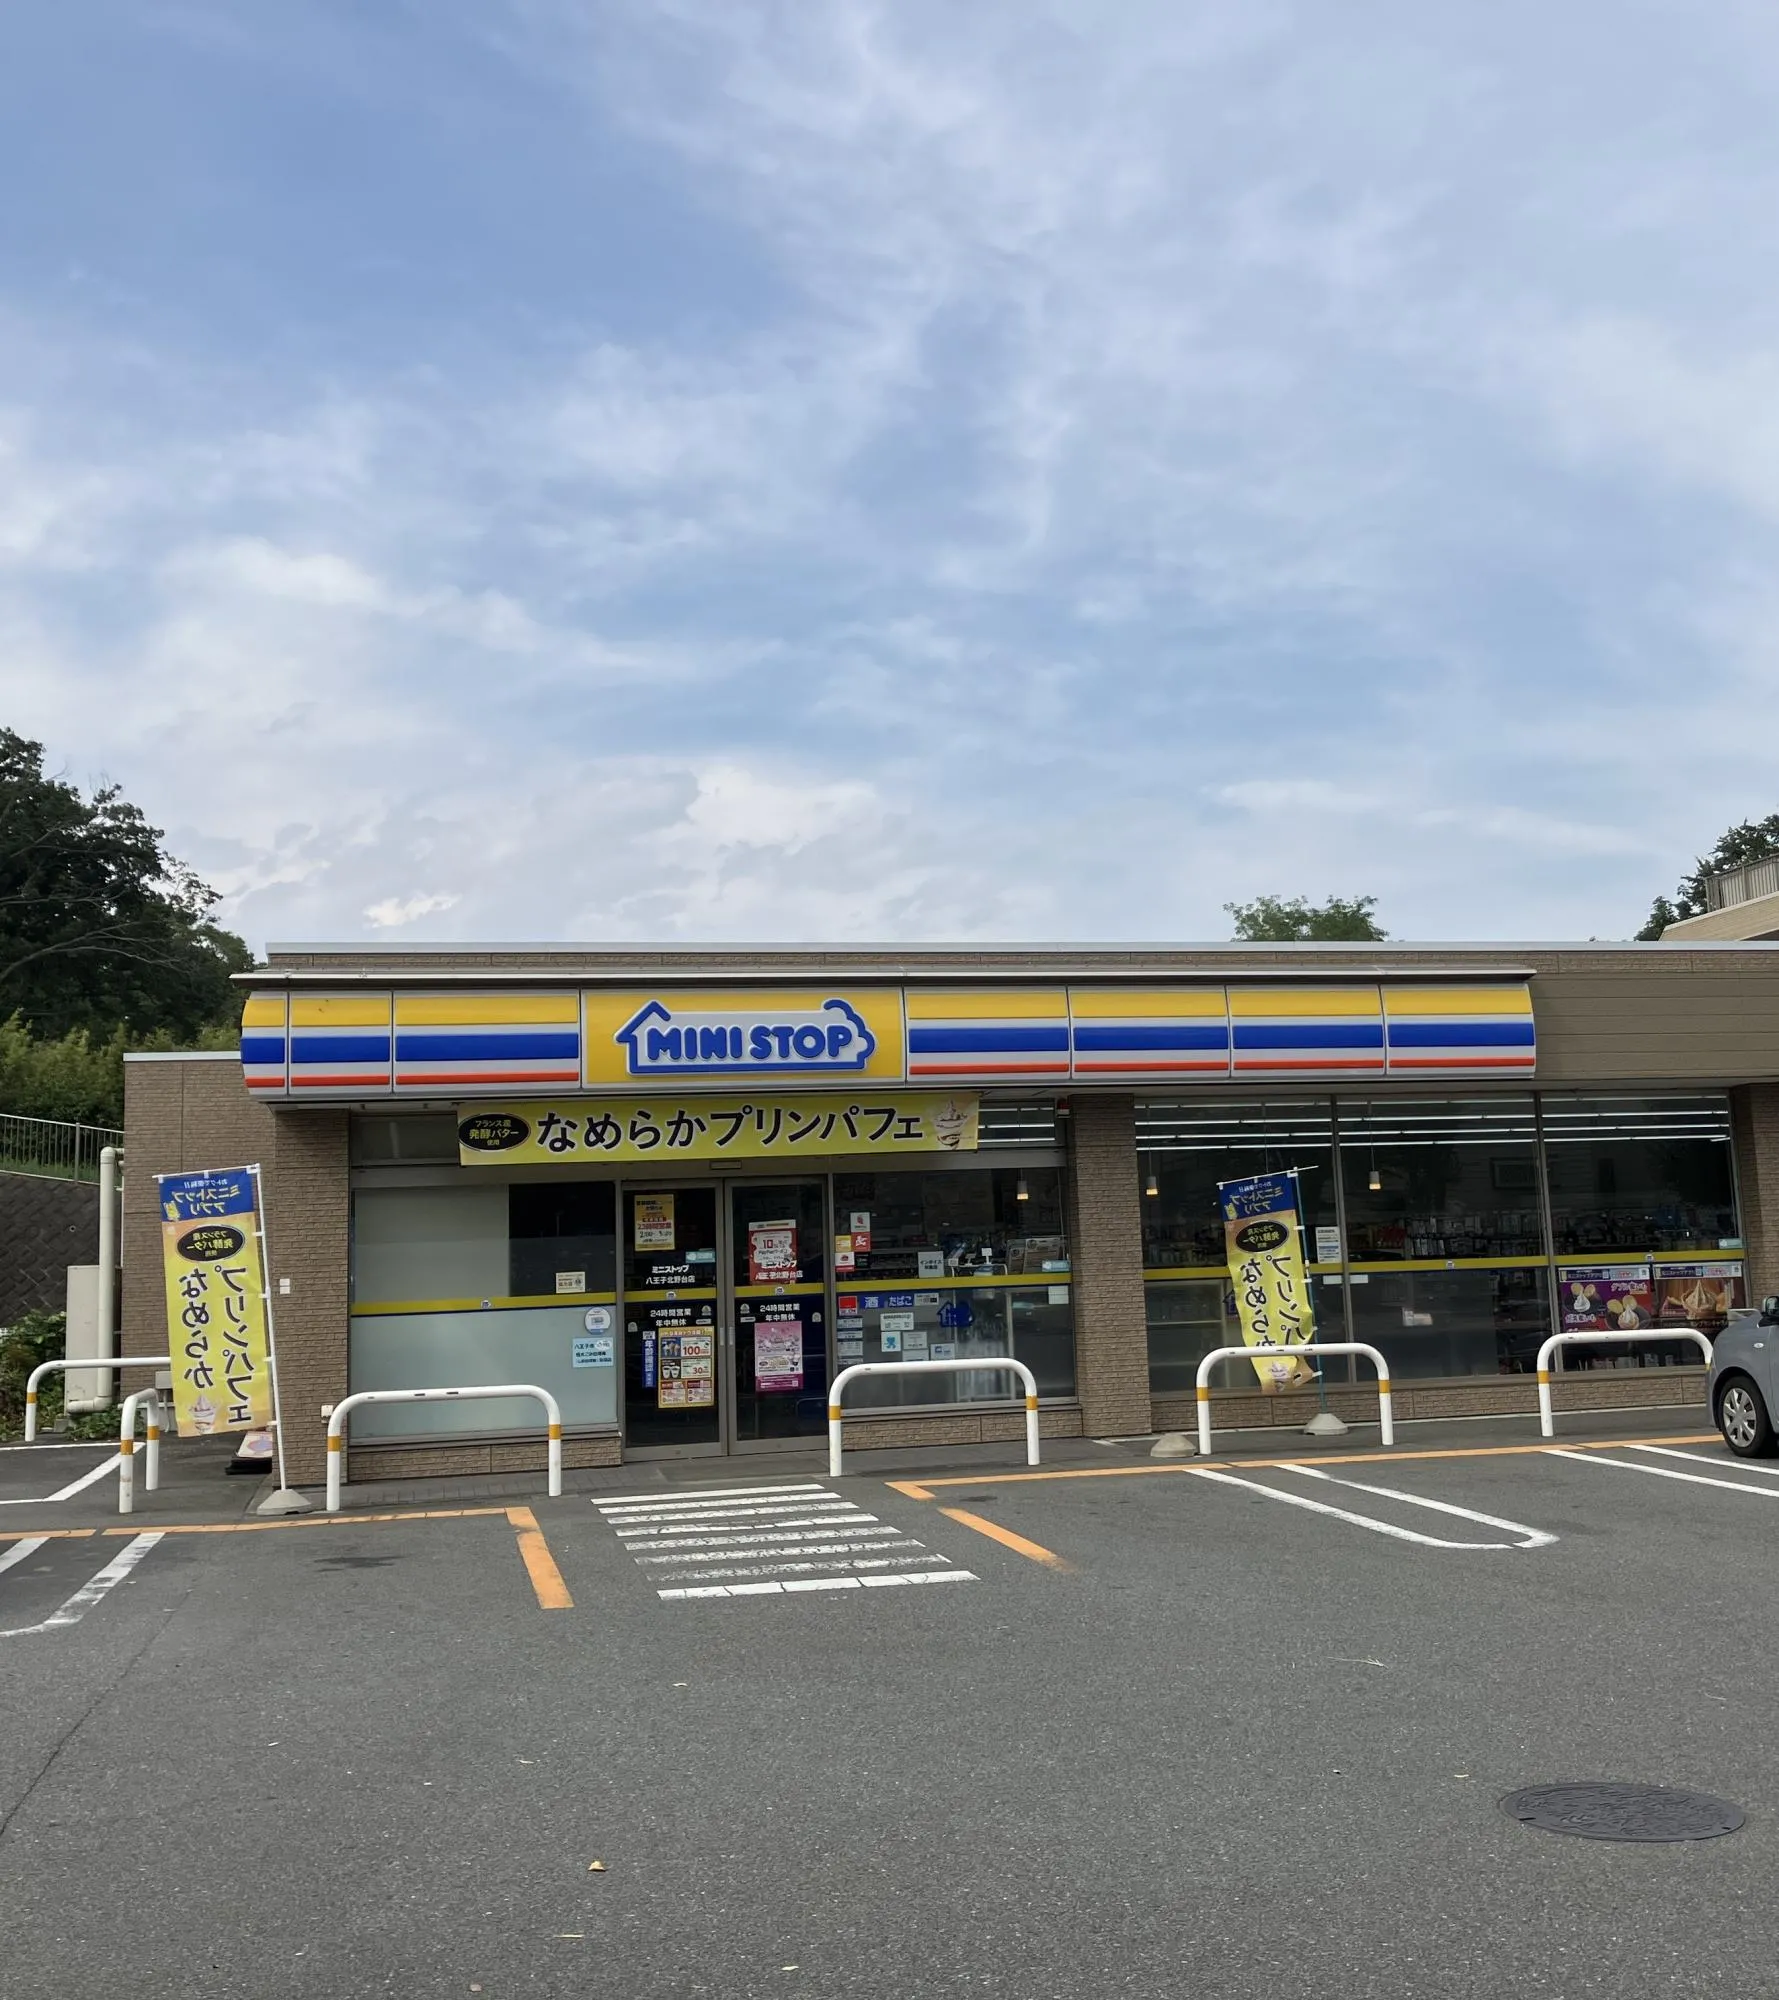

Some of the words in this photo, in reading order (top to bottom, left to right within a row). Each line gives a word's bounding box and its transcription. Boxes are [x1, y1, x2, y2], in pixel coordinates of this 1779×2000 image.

[476, 1119, 512, 1128] フランス産
[537, 1103, 923, 1152] なめらかプリンパフェ
[469, 1128, 520, 1140] 発酵バター
[652, 1264, 690, 1274] ミニストップ
[761, 1259, 798, 1269] ミニストップ
[646, 1275, 696, 1285] 八王子北野台店
[755, 1270, 804, 1280] 八王子北野台店
[865, 1296, 879, 1308] 酒
[888, 1295, 913, 1307] たばこ
[650, 1308, 692, 1317] 24時間営業
[760, 1303, 801, 1313] 24時間営業
[656, 1318, 687, 1327] 年中無休
[765, 1313, 796, 1322] 年中無休
[683, 1345, 701, 1355] 100
